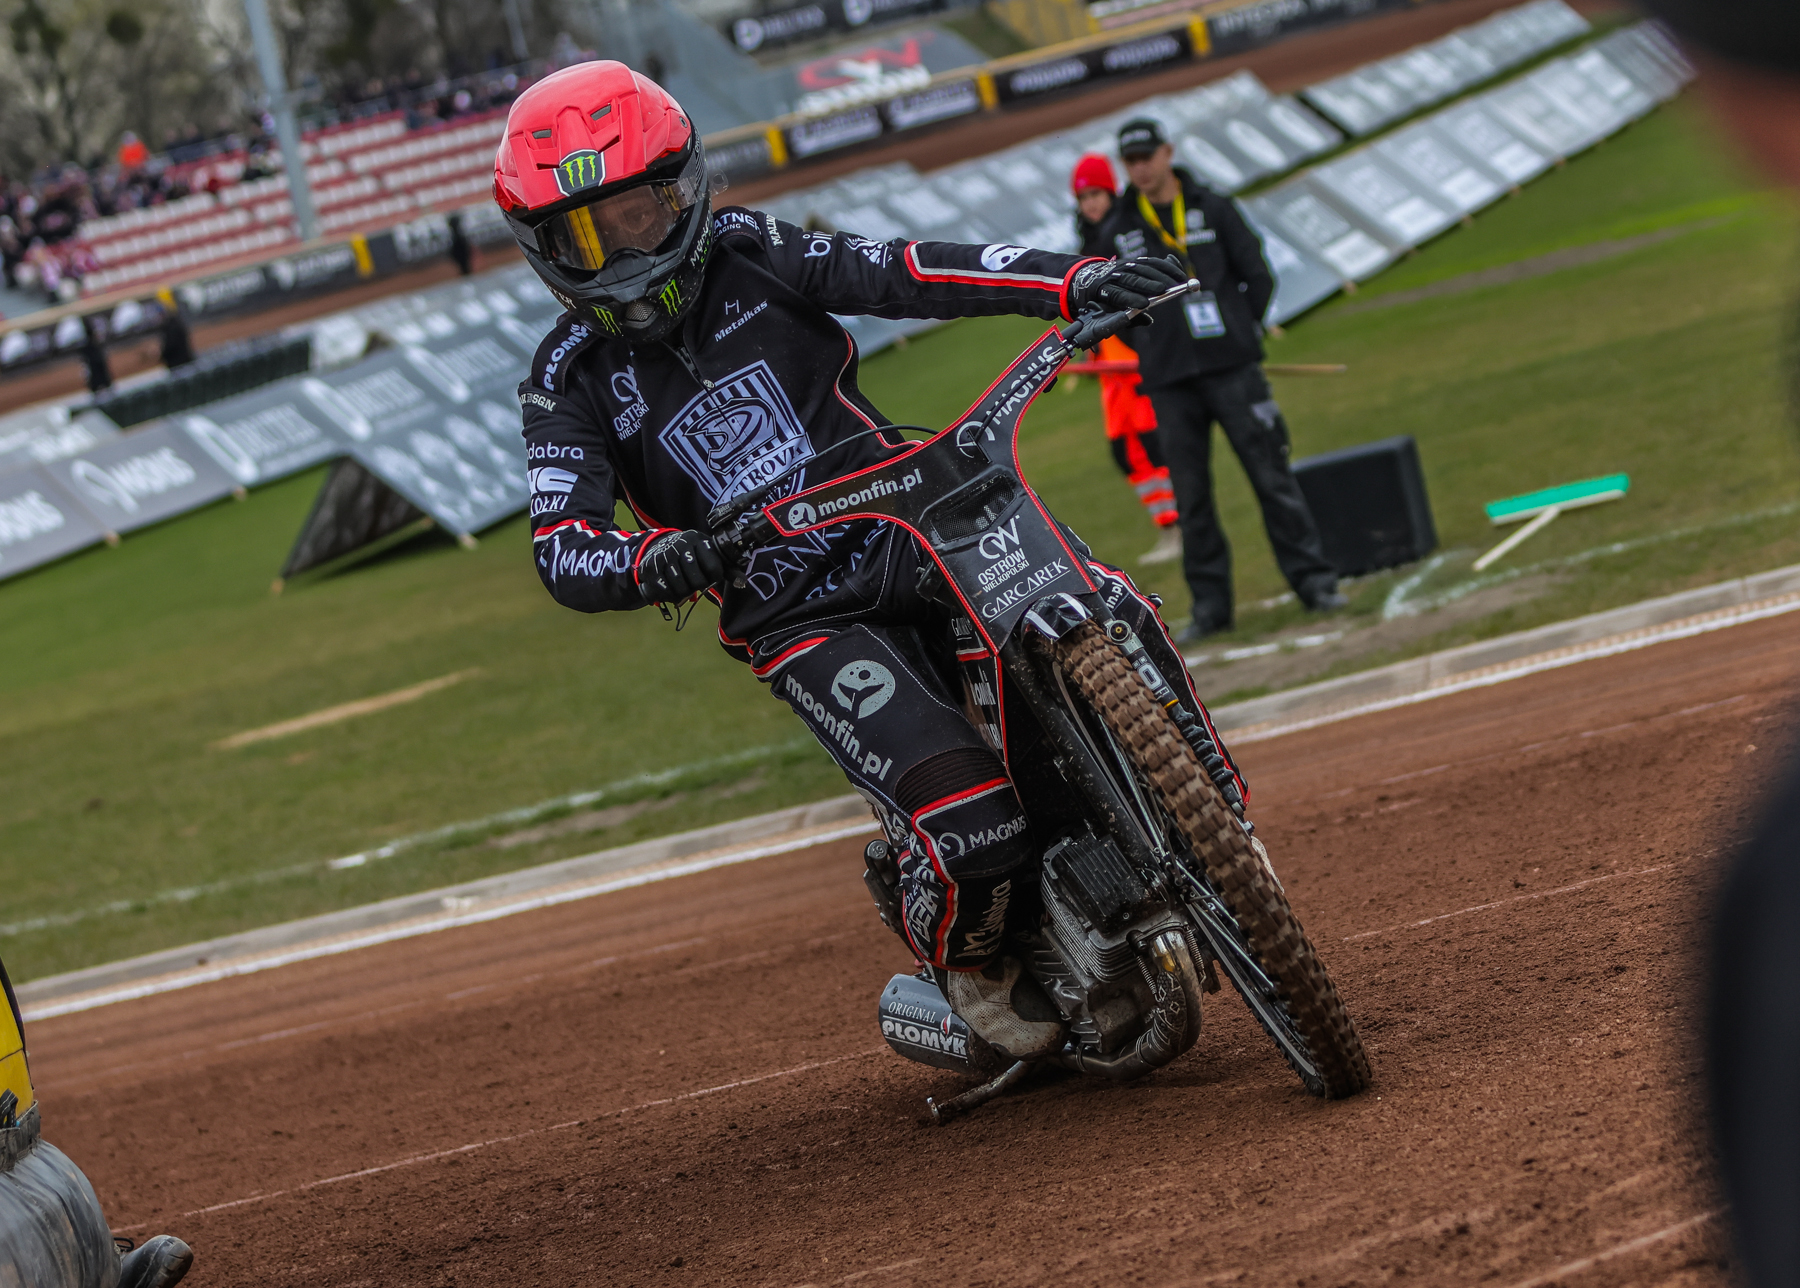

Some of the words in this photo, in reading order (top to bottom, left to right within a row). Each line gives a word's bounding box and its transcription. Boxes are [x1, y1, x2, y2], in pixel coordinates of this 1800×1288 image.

[714, 300, 769, 341] Metalkas
[543, 324, 592, 391] PŁOMY
[818, 468, 923, 516] moonfin.pl
[978, 548, 1026, 586] OSTRÓW
[982, 560, 1030, 593] WIELKOPOLSKI
[982, 557, 1068, 618] GARCAREK
[785, 673, 893, 781] moonfin.pl
[968, 815, 1027, 849] MAGNUS
[888, 1001, 937, 1024] ORIGINAL
